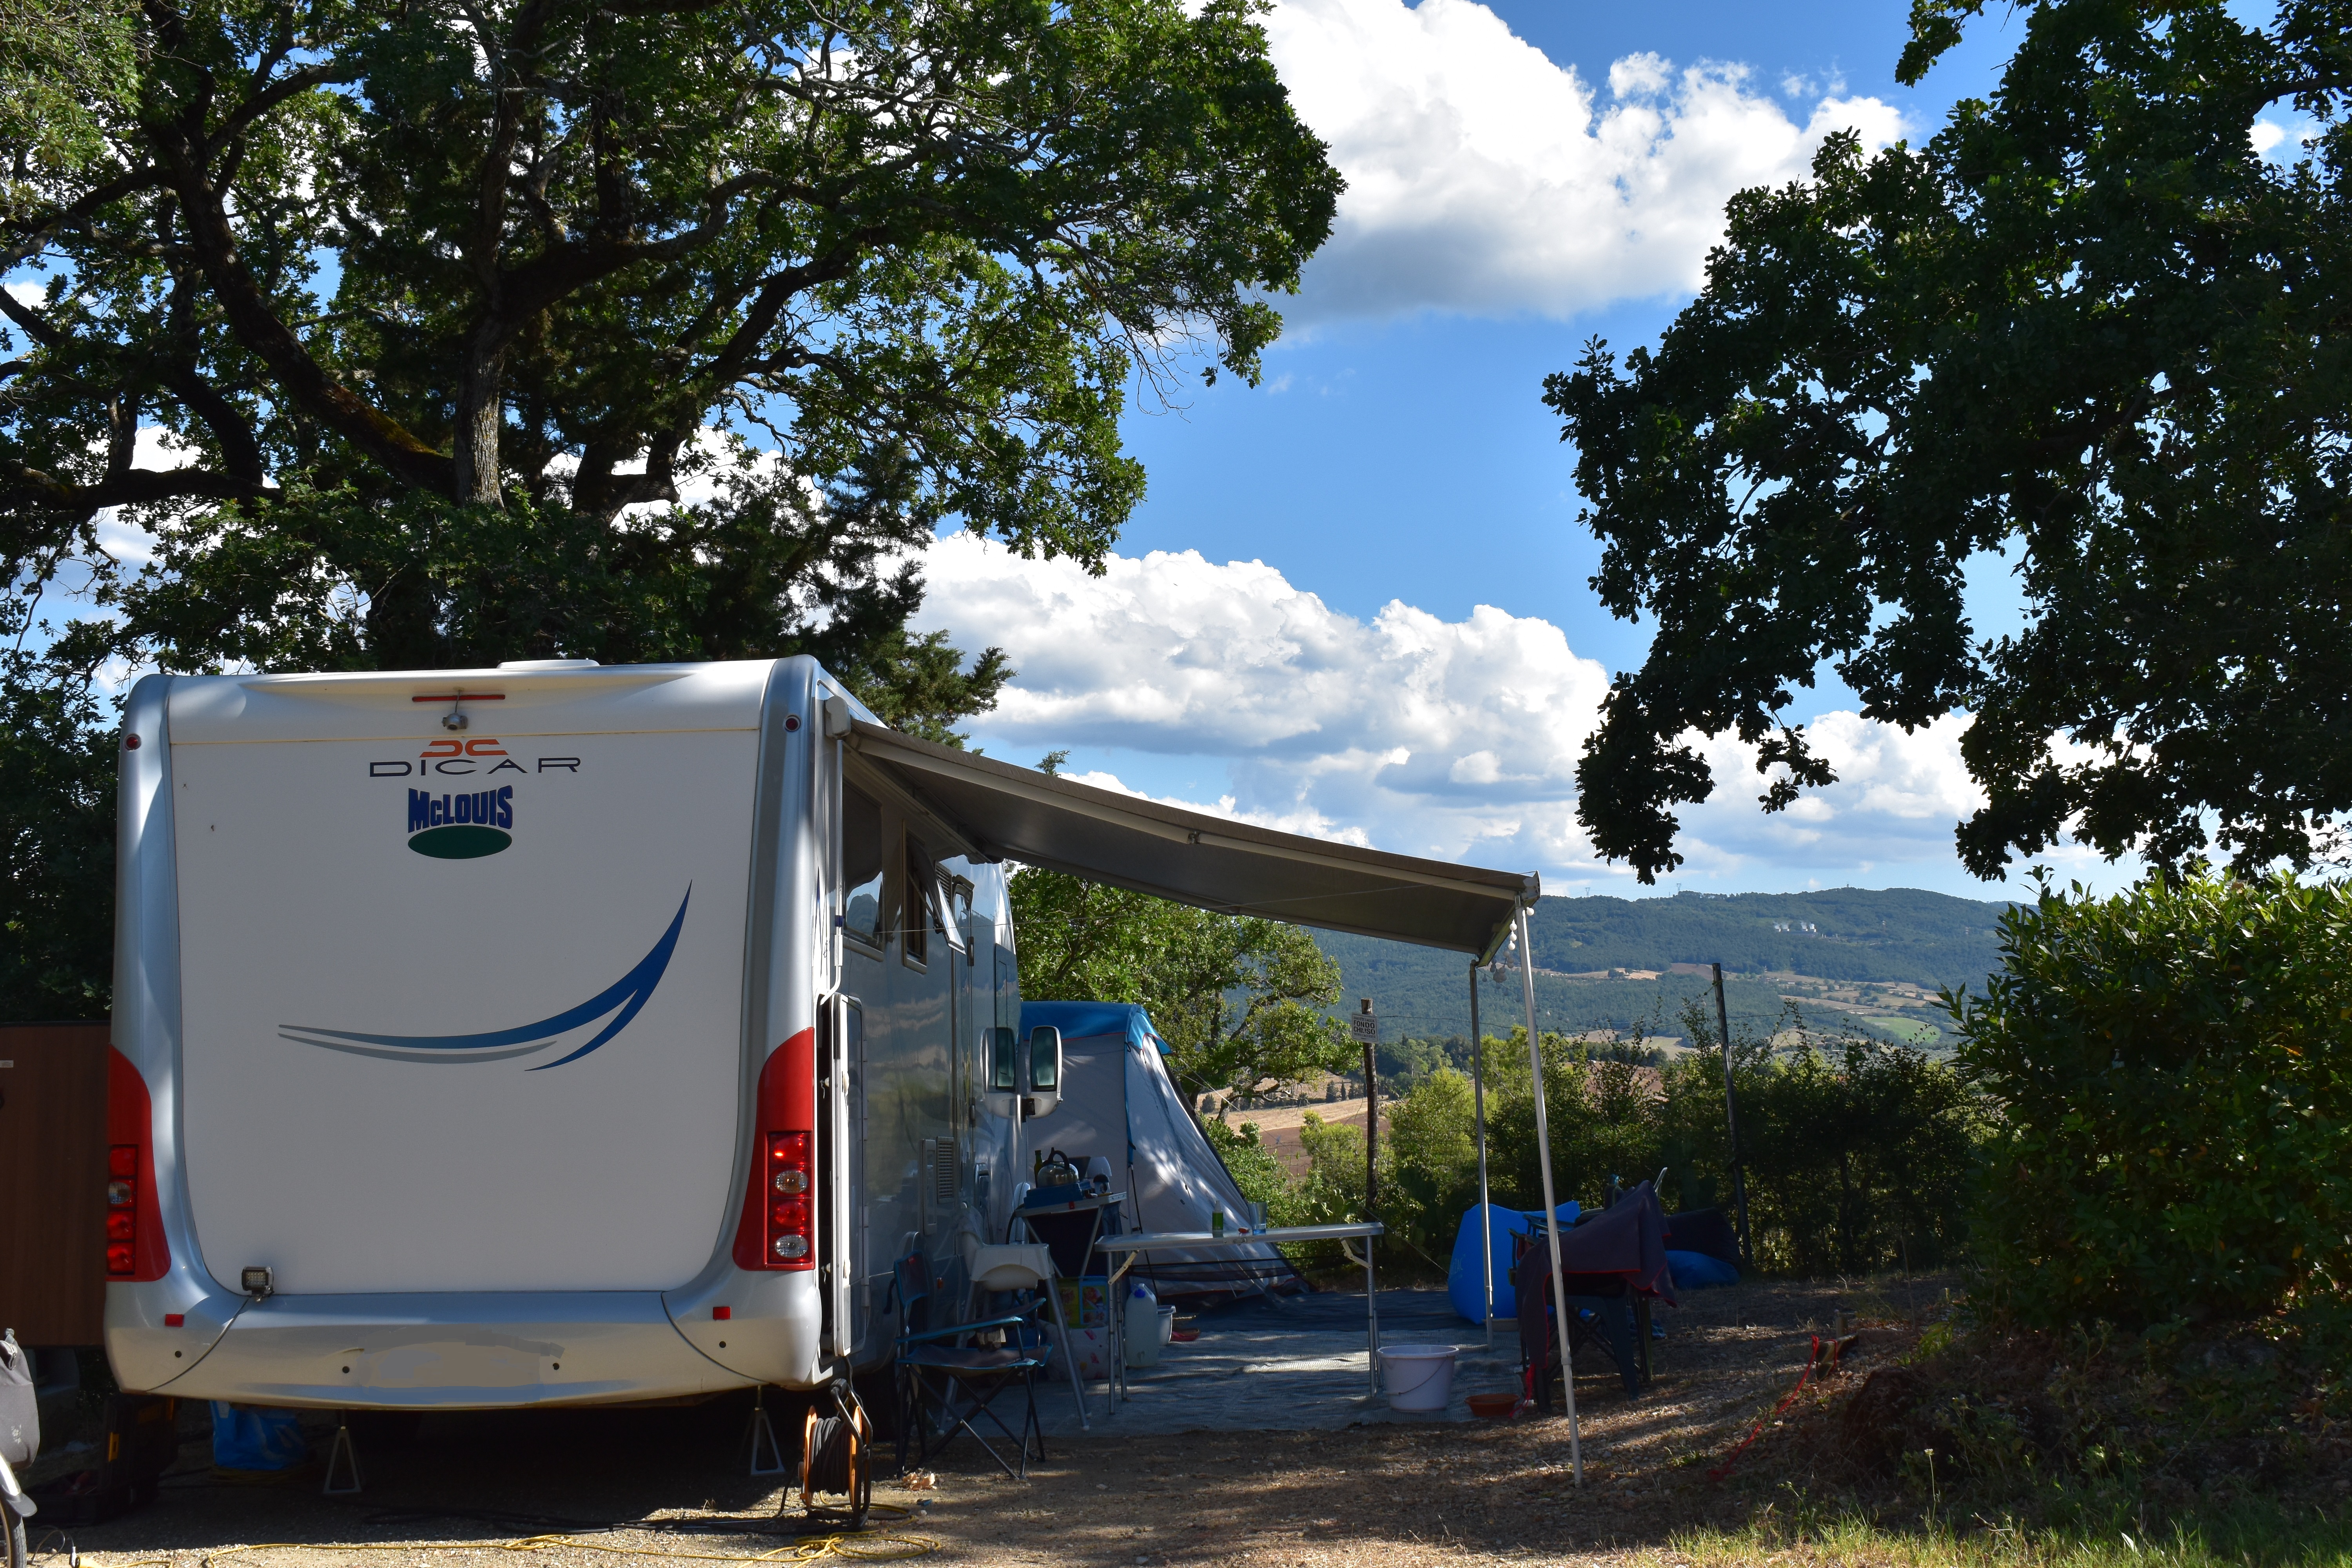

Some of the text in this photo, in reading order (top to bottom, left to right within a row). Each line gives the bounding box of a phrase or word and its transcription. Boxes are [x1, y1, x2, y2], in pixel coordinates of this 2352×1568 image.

[370, 757, 581, 777] DICAR
[1354, 1020, 1375, 1029] FONDO
[1354, 1026, 1376, 1035] CHIUSO
